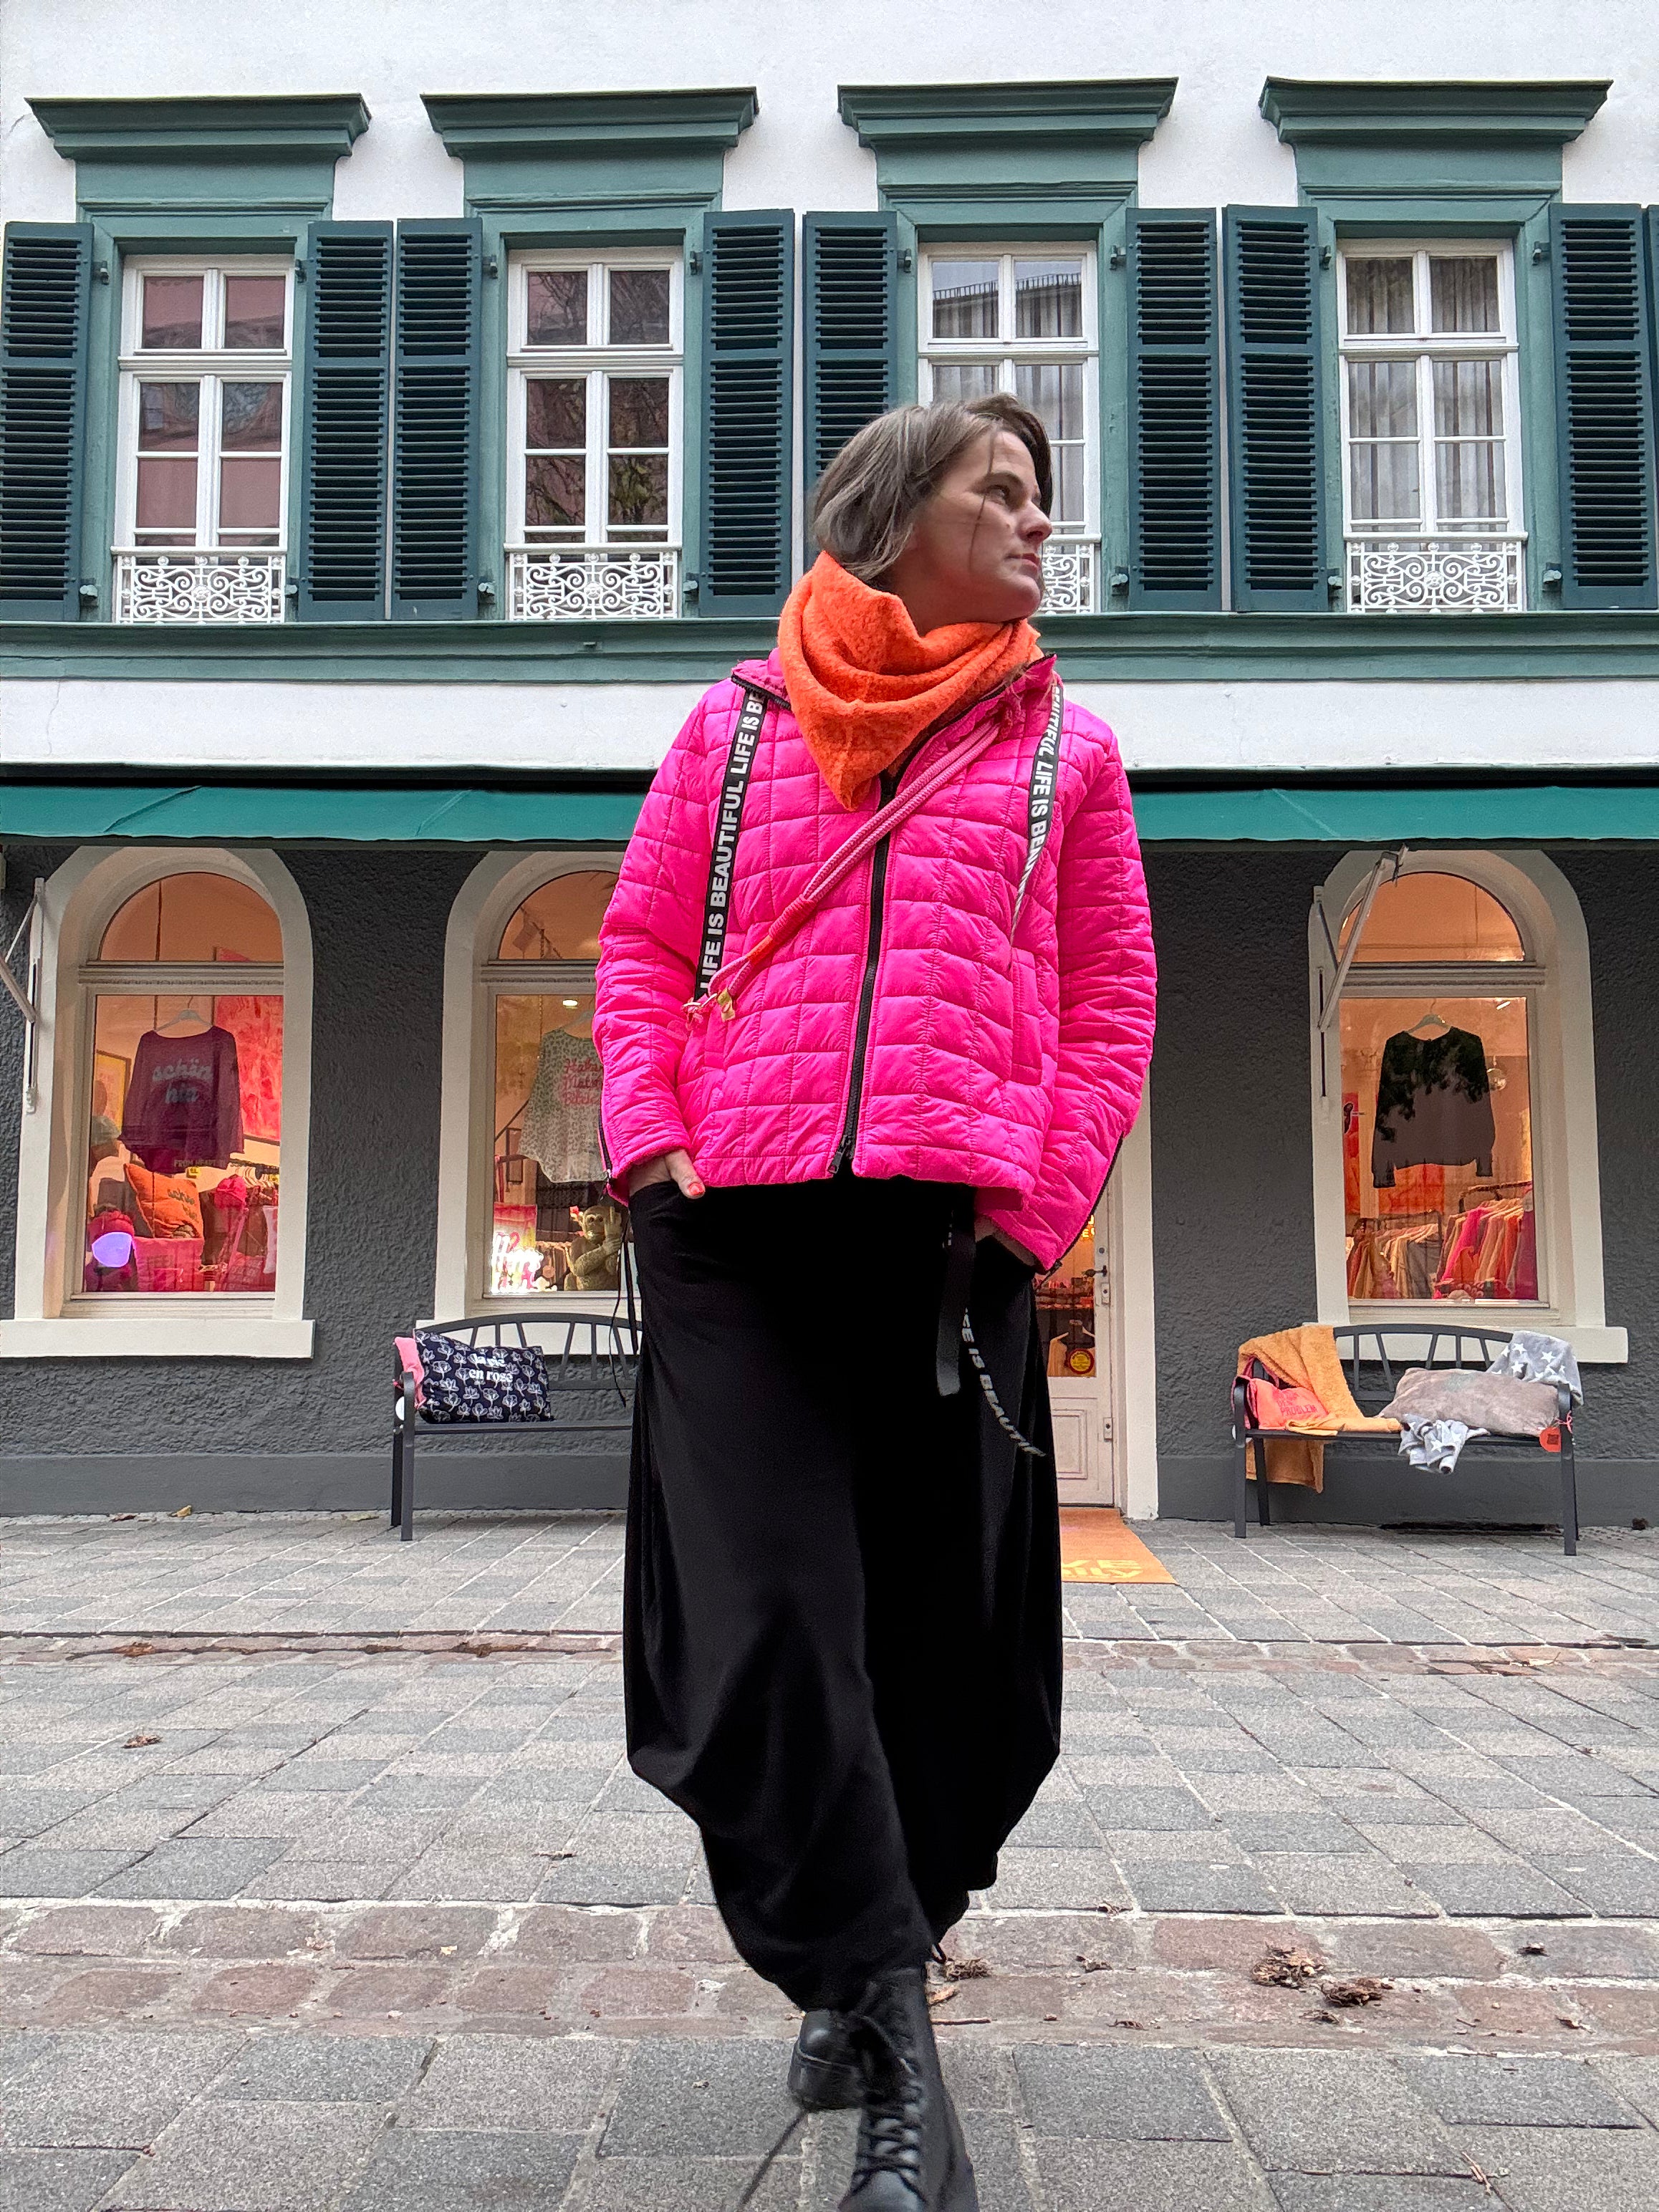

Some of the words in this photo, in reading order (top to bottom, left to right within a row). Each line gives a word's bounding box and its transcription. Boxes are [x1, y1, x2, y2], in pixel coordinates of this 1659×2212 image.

[741, 716, 759, 731] IS
[730, 731, 755, 774] LIFE
[1033, 760, 1054, 796] LIFE
[1031, 799, 1049, 818] IS
[710, 780, 744, 908] BEAUTIFUL
[707, 913, 724, 936] IS
[468, 1369, 484, 1380] en
[486, 1371, 514, 1383] rose
